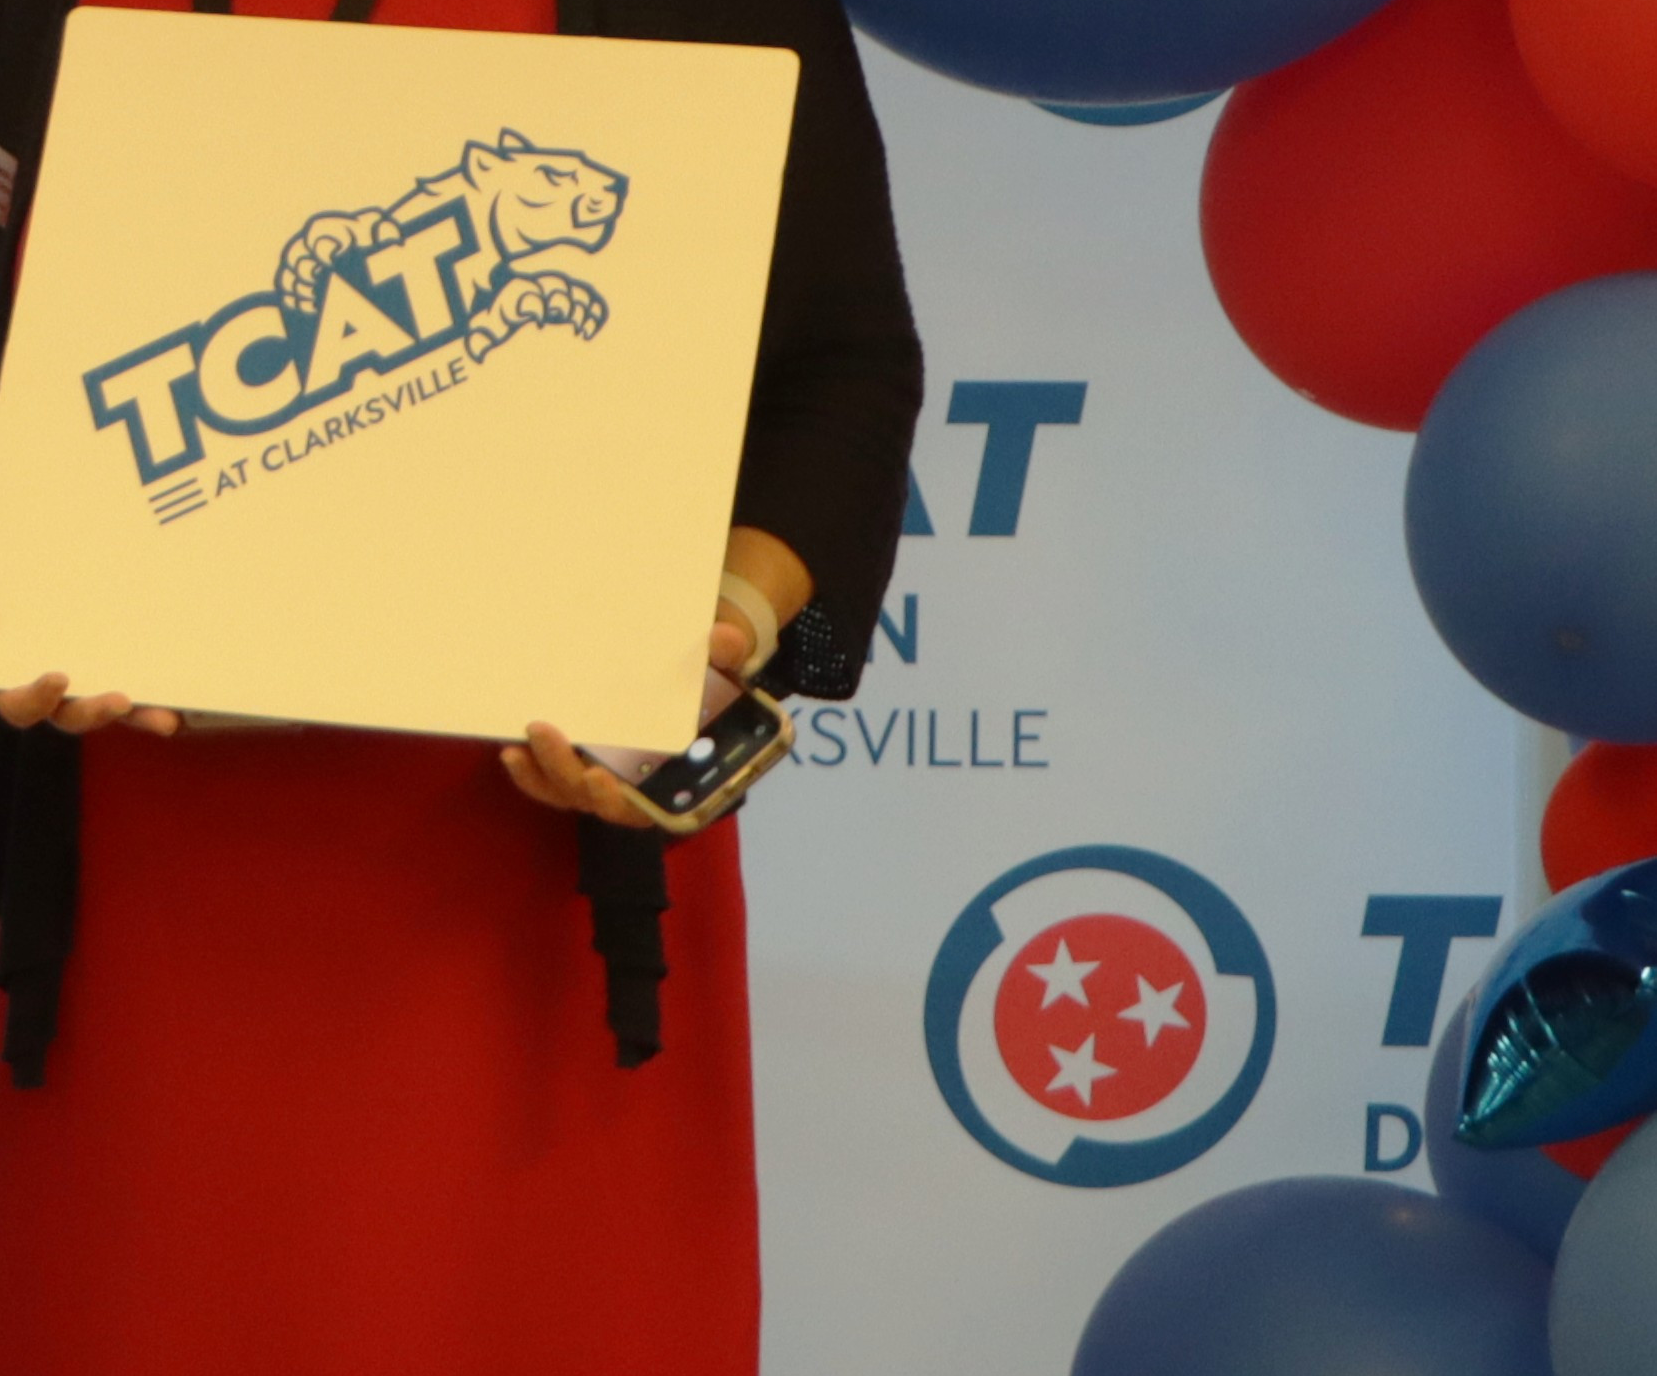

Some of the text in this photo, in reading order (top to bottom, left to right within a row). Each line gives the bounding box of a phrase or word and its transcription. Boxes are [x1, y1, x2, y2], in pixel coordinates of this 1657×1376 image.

[82, 195, 479, 485] TCAT
[214, 357, 469, 498] AT CLARKSVILLE
